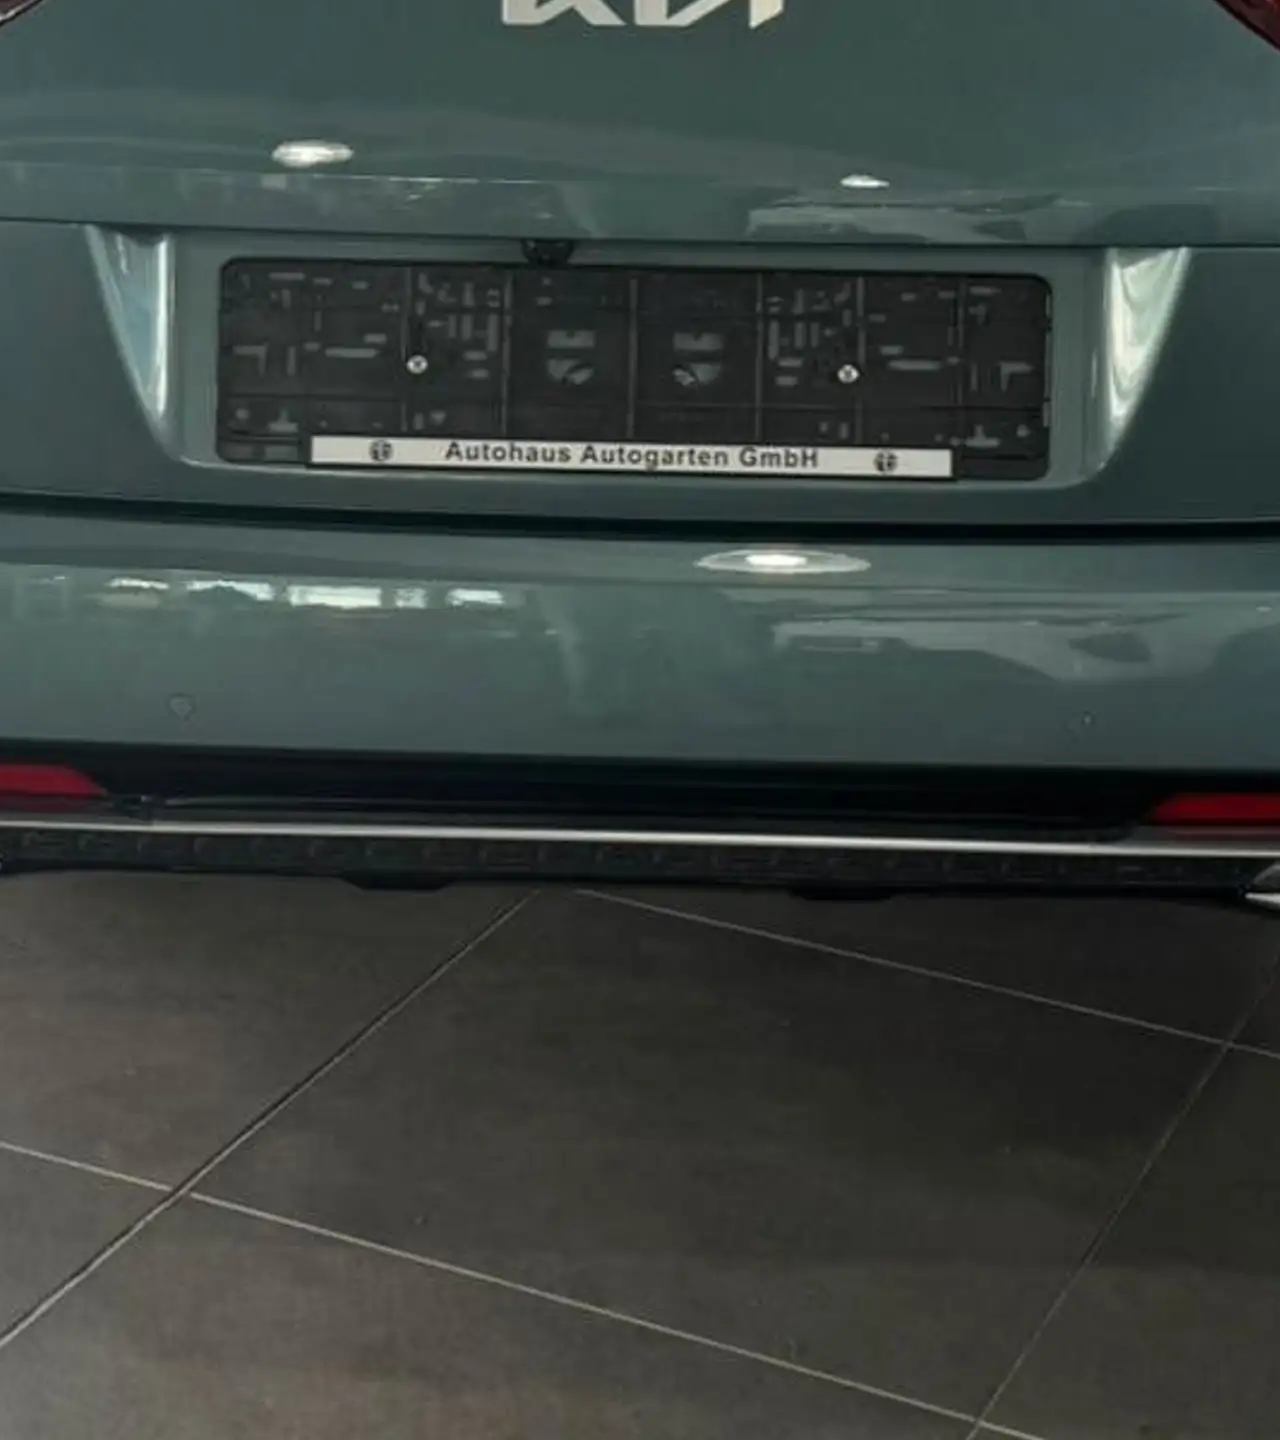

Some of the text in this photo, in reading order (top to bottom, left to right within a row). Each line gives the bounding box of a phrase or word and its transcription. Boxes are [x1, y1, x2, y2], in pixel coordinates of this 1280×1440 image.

[445, 441, 819, 472] Autohaus Autogarten GmbH
